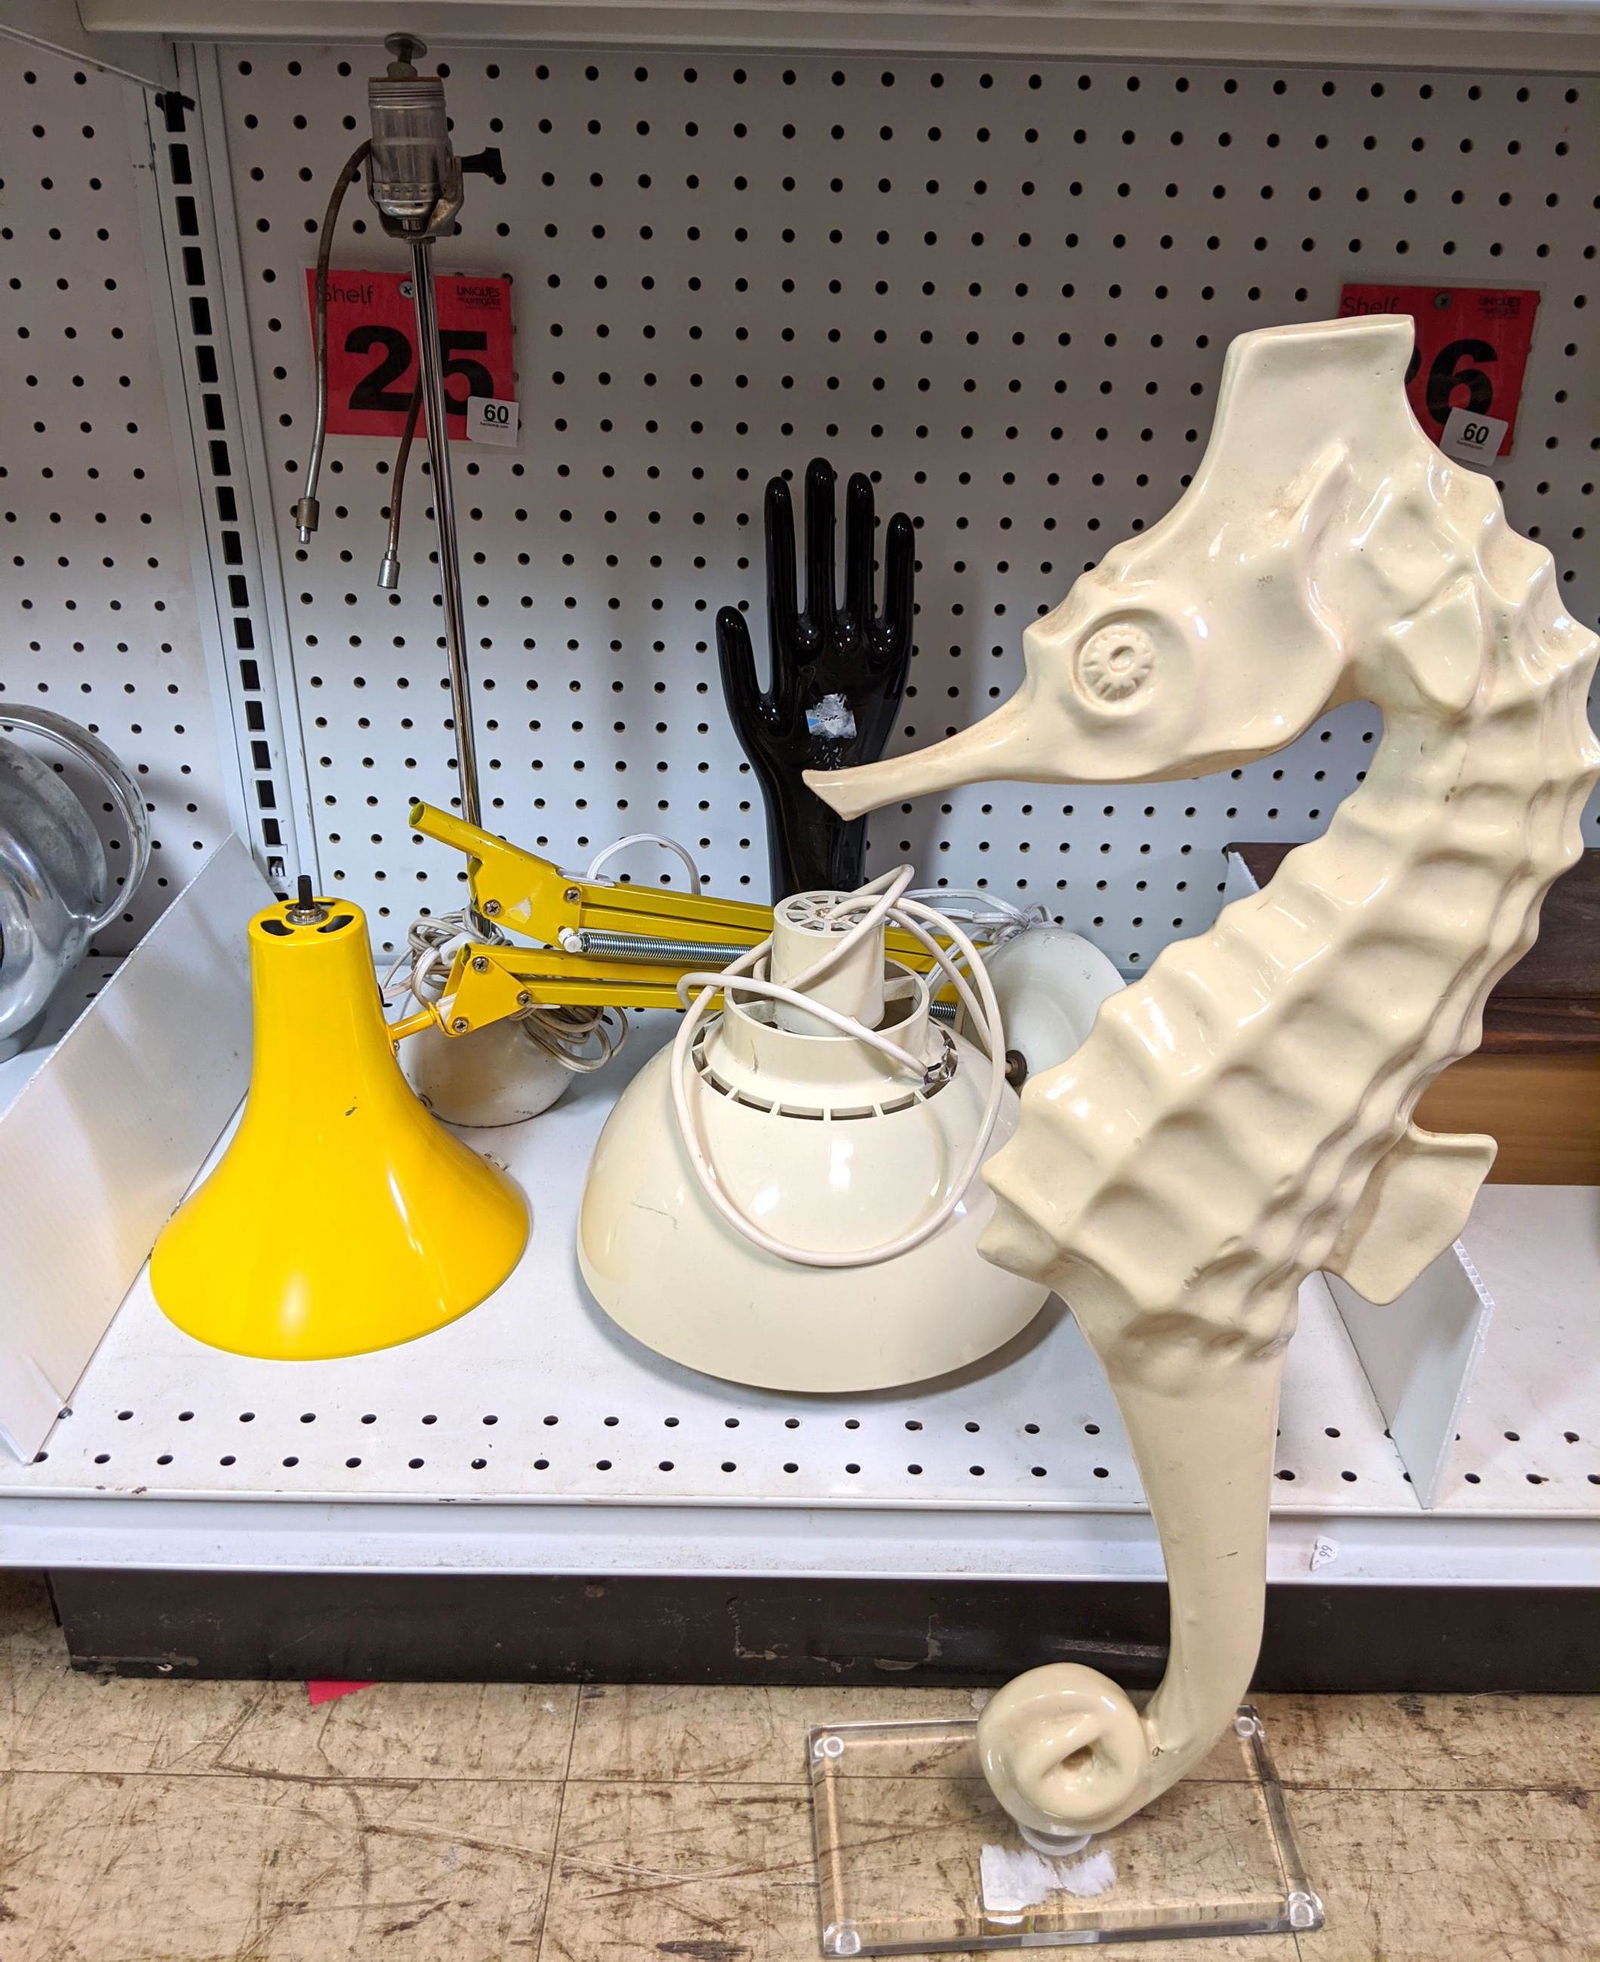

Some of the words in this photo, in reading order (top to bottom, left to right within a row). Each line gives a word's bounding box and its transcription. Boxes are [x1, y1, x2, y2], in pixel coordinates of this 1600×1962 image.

[1342, 296, 1400, 316] Shelf
[344, 325, 494, 416] 25
[1404, 338, 1498, 425] 6
[483, 404, 509, 423] 60
[1463, 423, 1490, 444] 60
